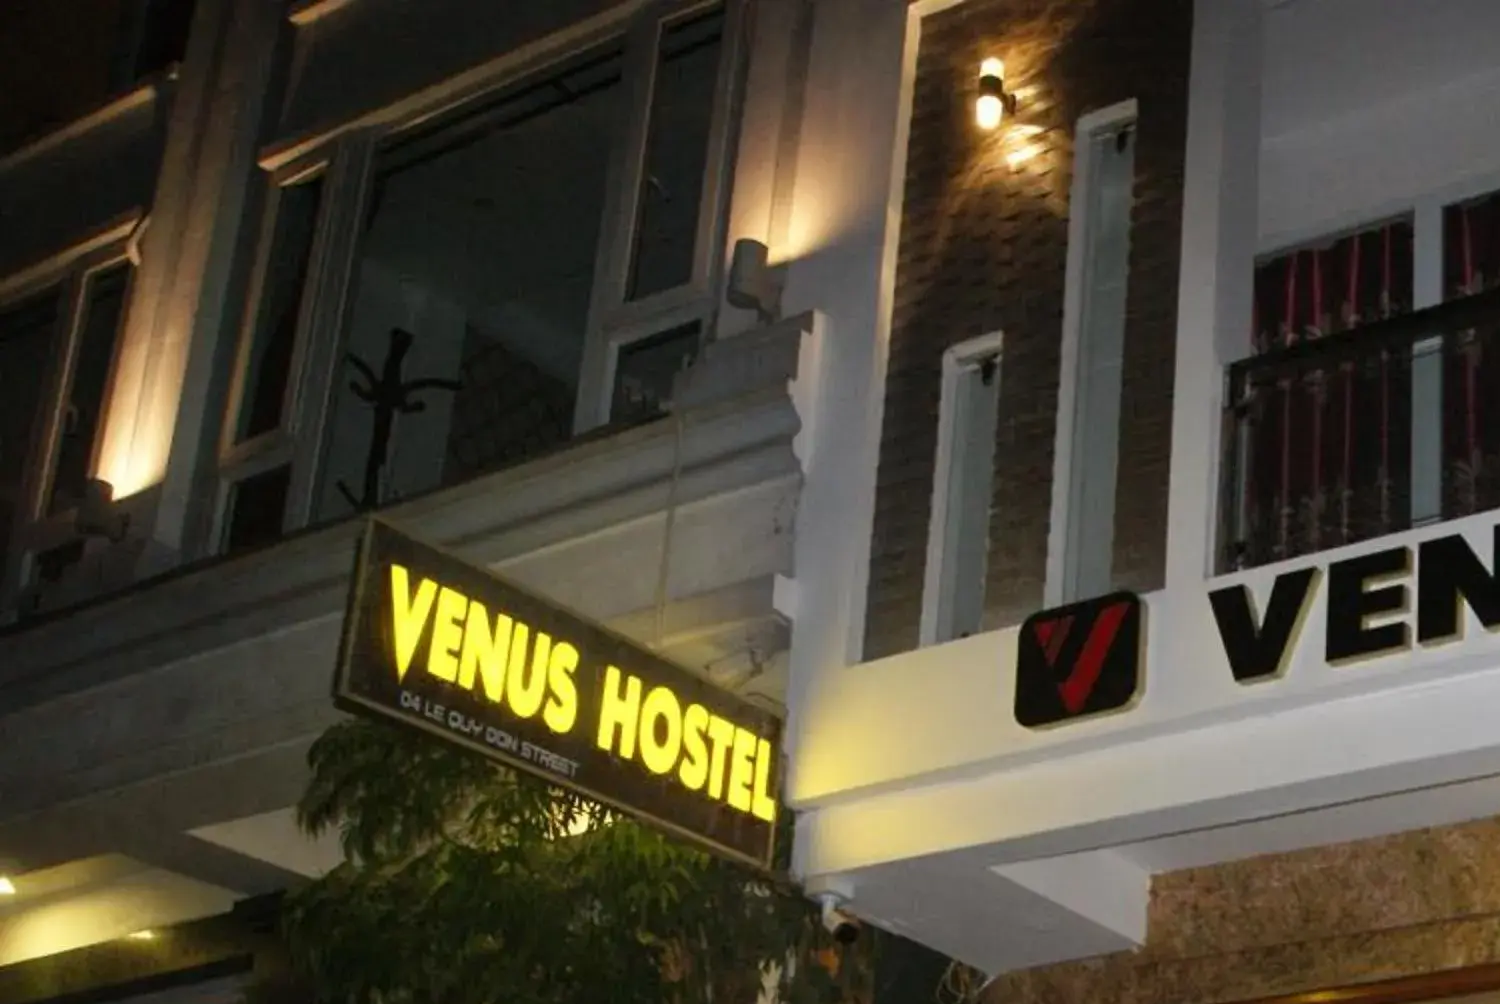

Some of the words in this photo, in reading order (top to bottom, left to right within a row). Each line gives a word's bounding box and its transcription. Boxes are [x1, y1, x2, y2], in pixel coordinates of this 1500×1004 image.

[391, 565, 579, 733] VENUS
[598, 666, 776, 822] HOSTEL
[400, 690, 420, 712] 04
[425, 701, 446, 722] LE
[448, 710, 483, 736] QUY
[485, 726, 518, 752] DON
[520, 742, 580, 778] STREET
